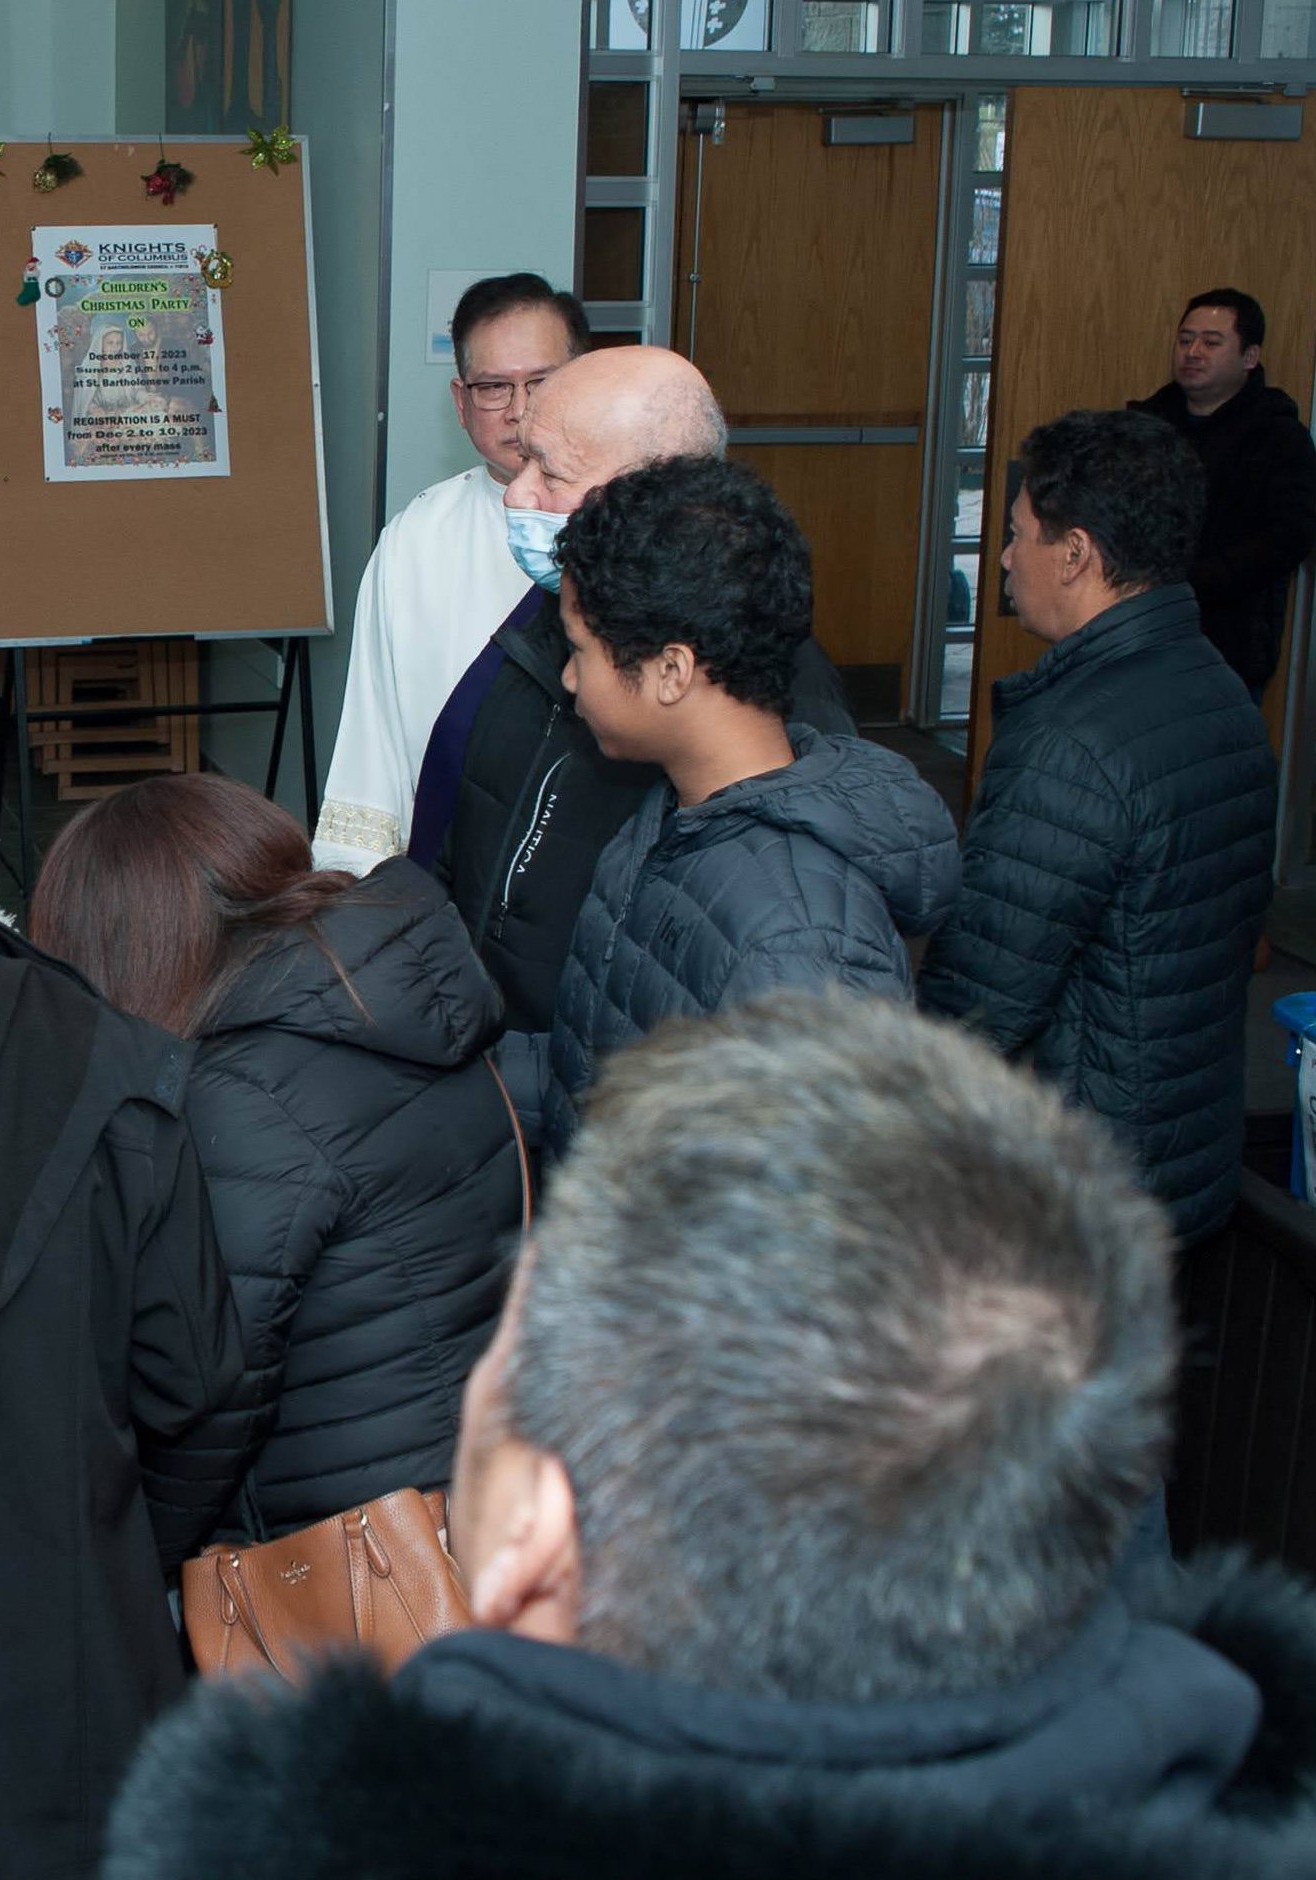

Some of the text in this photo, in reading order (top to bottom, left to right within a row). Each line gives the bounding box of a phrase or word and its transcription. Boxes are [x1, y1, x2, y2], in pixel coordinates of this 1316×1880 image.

[98, 242, 186, 254] KNIGHTS
[89, 352, 140, 360] December
[161, 350, 187, 359] 2023
[76, 366, 124, 374] Sunday
[125, 364, 132, 372] 2
[159, 364, 170, 372] to
[172, 363, 178, 372] 4
[73, 376, 204, 388] at St. Bartholomew Parish
[73, 414, 200, 426] REGISTRATION IS A MUST
[68, 430, 92, 440] from
[95, 430, 122, 439] Dec
[126, 429, 136, 438] 2
[139, 428, 154, 438] to
[95, 442, 182, 452] after every mass
